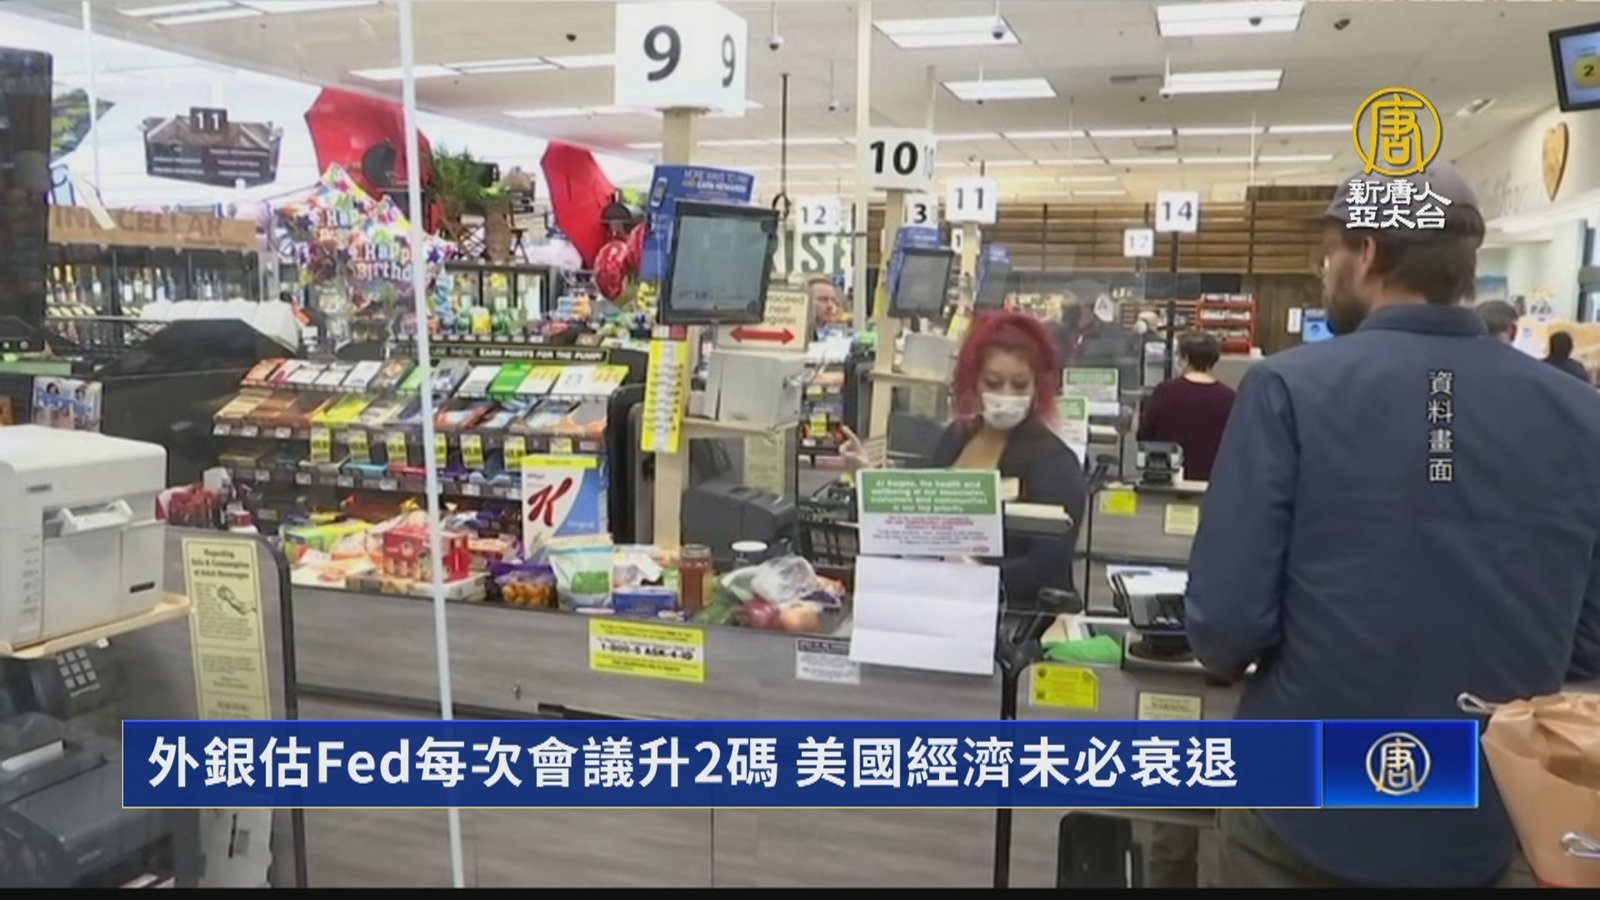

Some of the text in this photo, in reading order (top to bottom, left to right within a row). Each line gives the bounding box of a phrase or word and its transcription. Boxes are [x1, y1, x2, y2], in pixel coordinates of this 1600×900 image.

[643, 24, 682, 82] 9
[721, 34, 736, 88] 9
[1583, 65, 1594, 77] 2
[197, 112, 219, 131] 11
[870, 140, 919, 176] 10
[956, 188, 983, 210] 11
[55, 204, 223, 237] IN CELLAR
[802, 206, 827, 225] 12
[1162, 201, 1192, 221] 14
[504, 349, 534, 359] POINTS
[535, 350, 554, 359] FOR
[556, 351, 572, 360] THE
[528, 477, 572, 527] K
